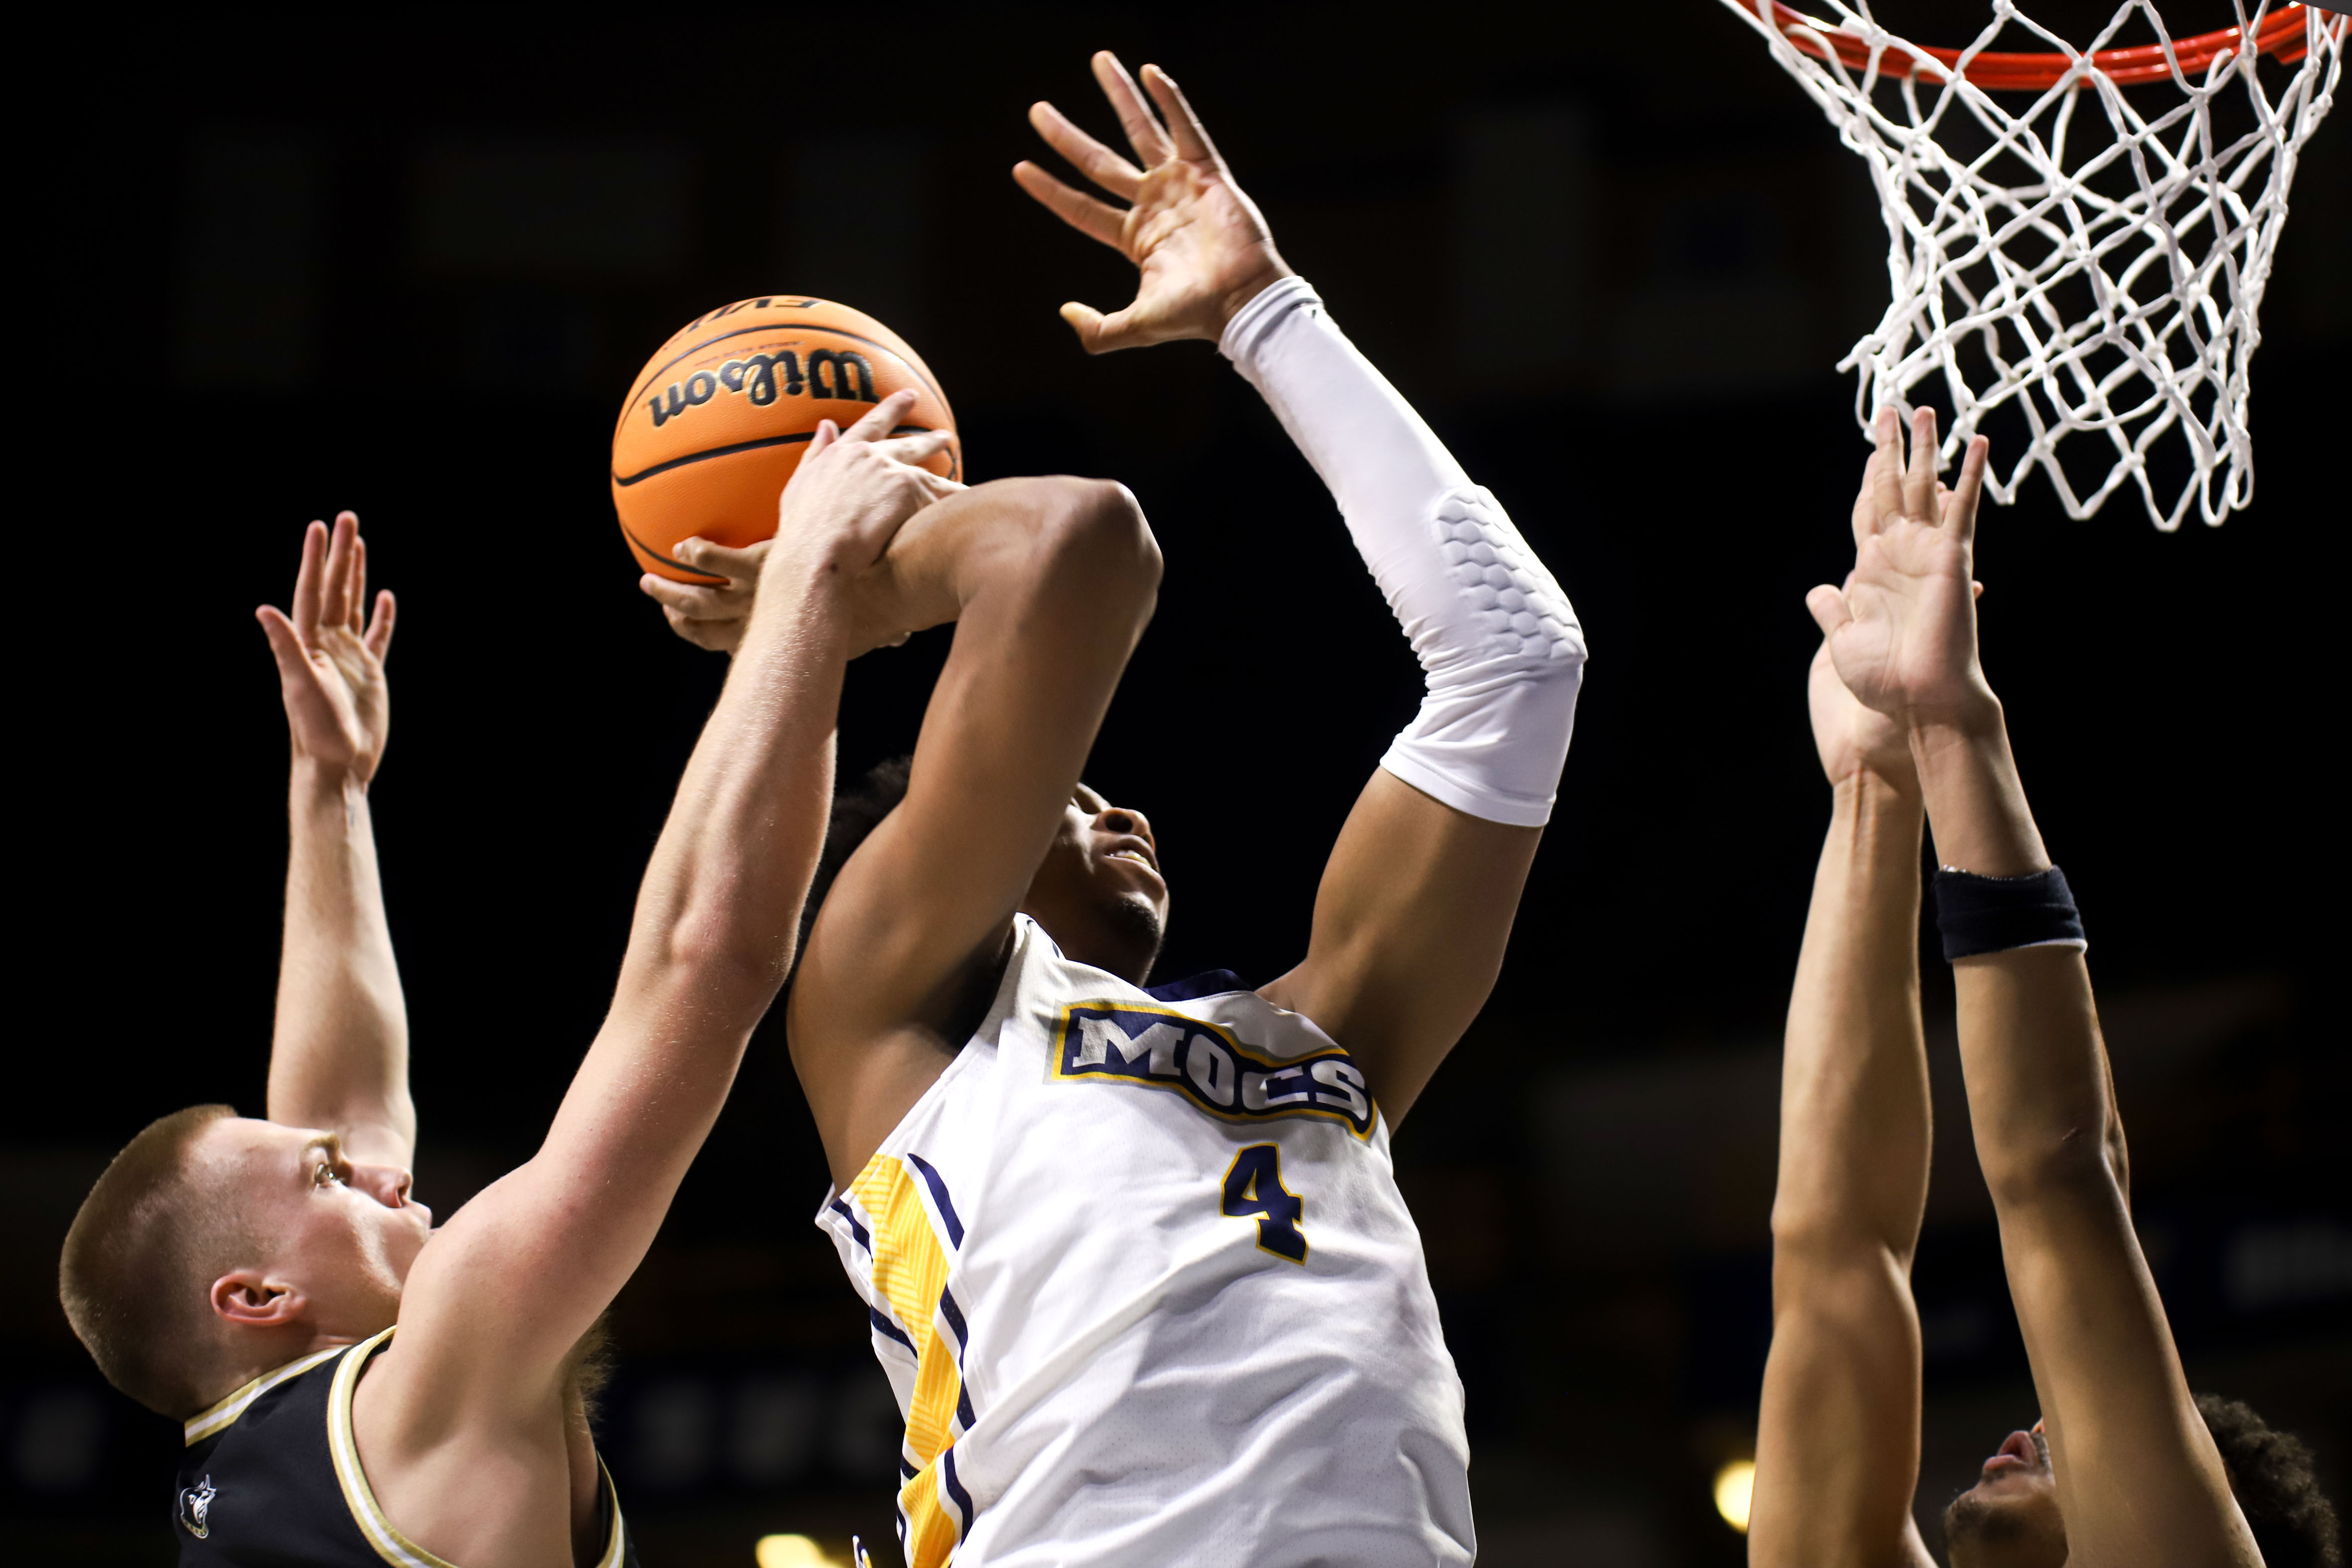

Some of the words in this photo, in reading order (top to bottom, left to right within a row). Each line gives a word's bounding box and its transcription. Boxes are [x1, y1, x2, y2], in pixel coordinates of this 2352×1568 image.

[649, 349, 881, 427] Wilson
[1071, 1016, 1368, 1121] MOCS
[1220, 1142, 1309, 1266] 4
